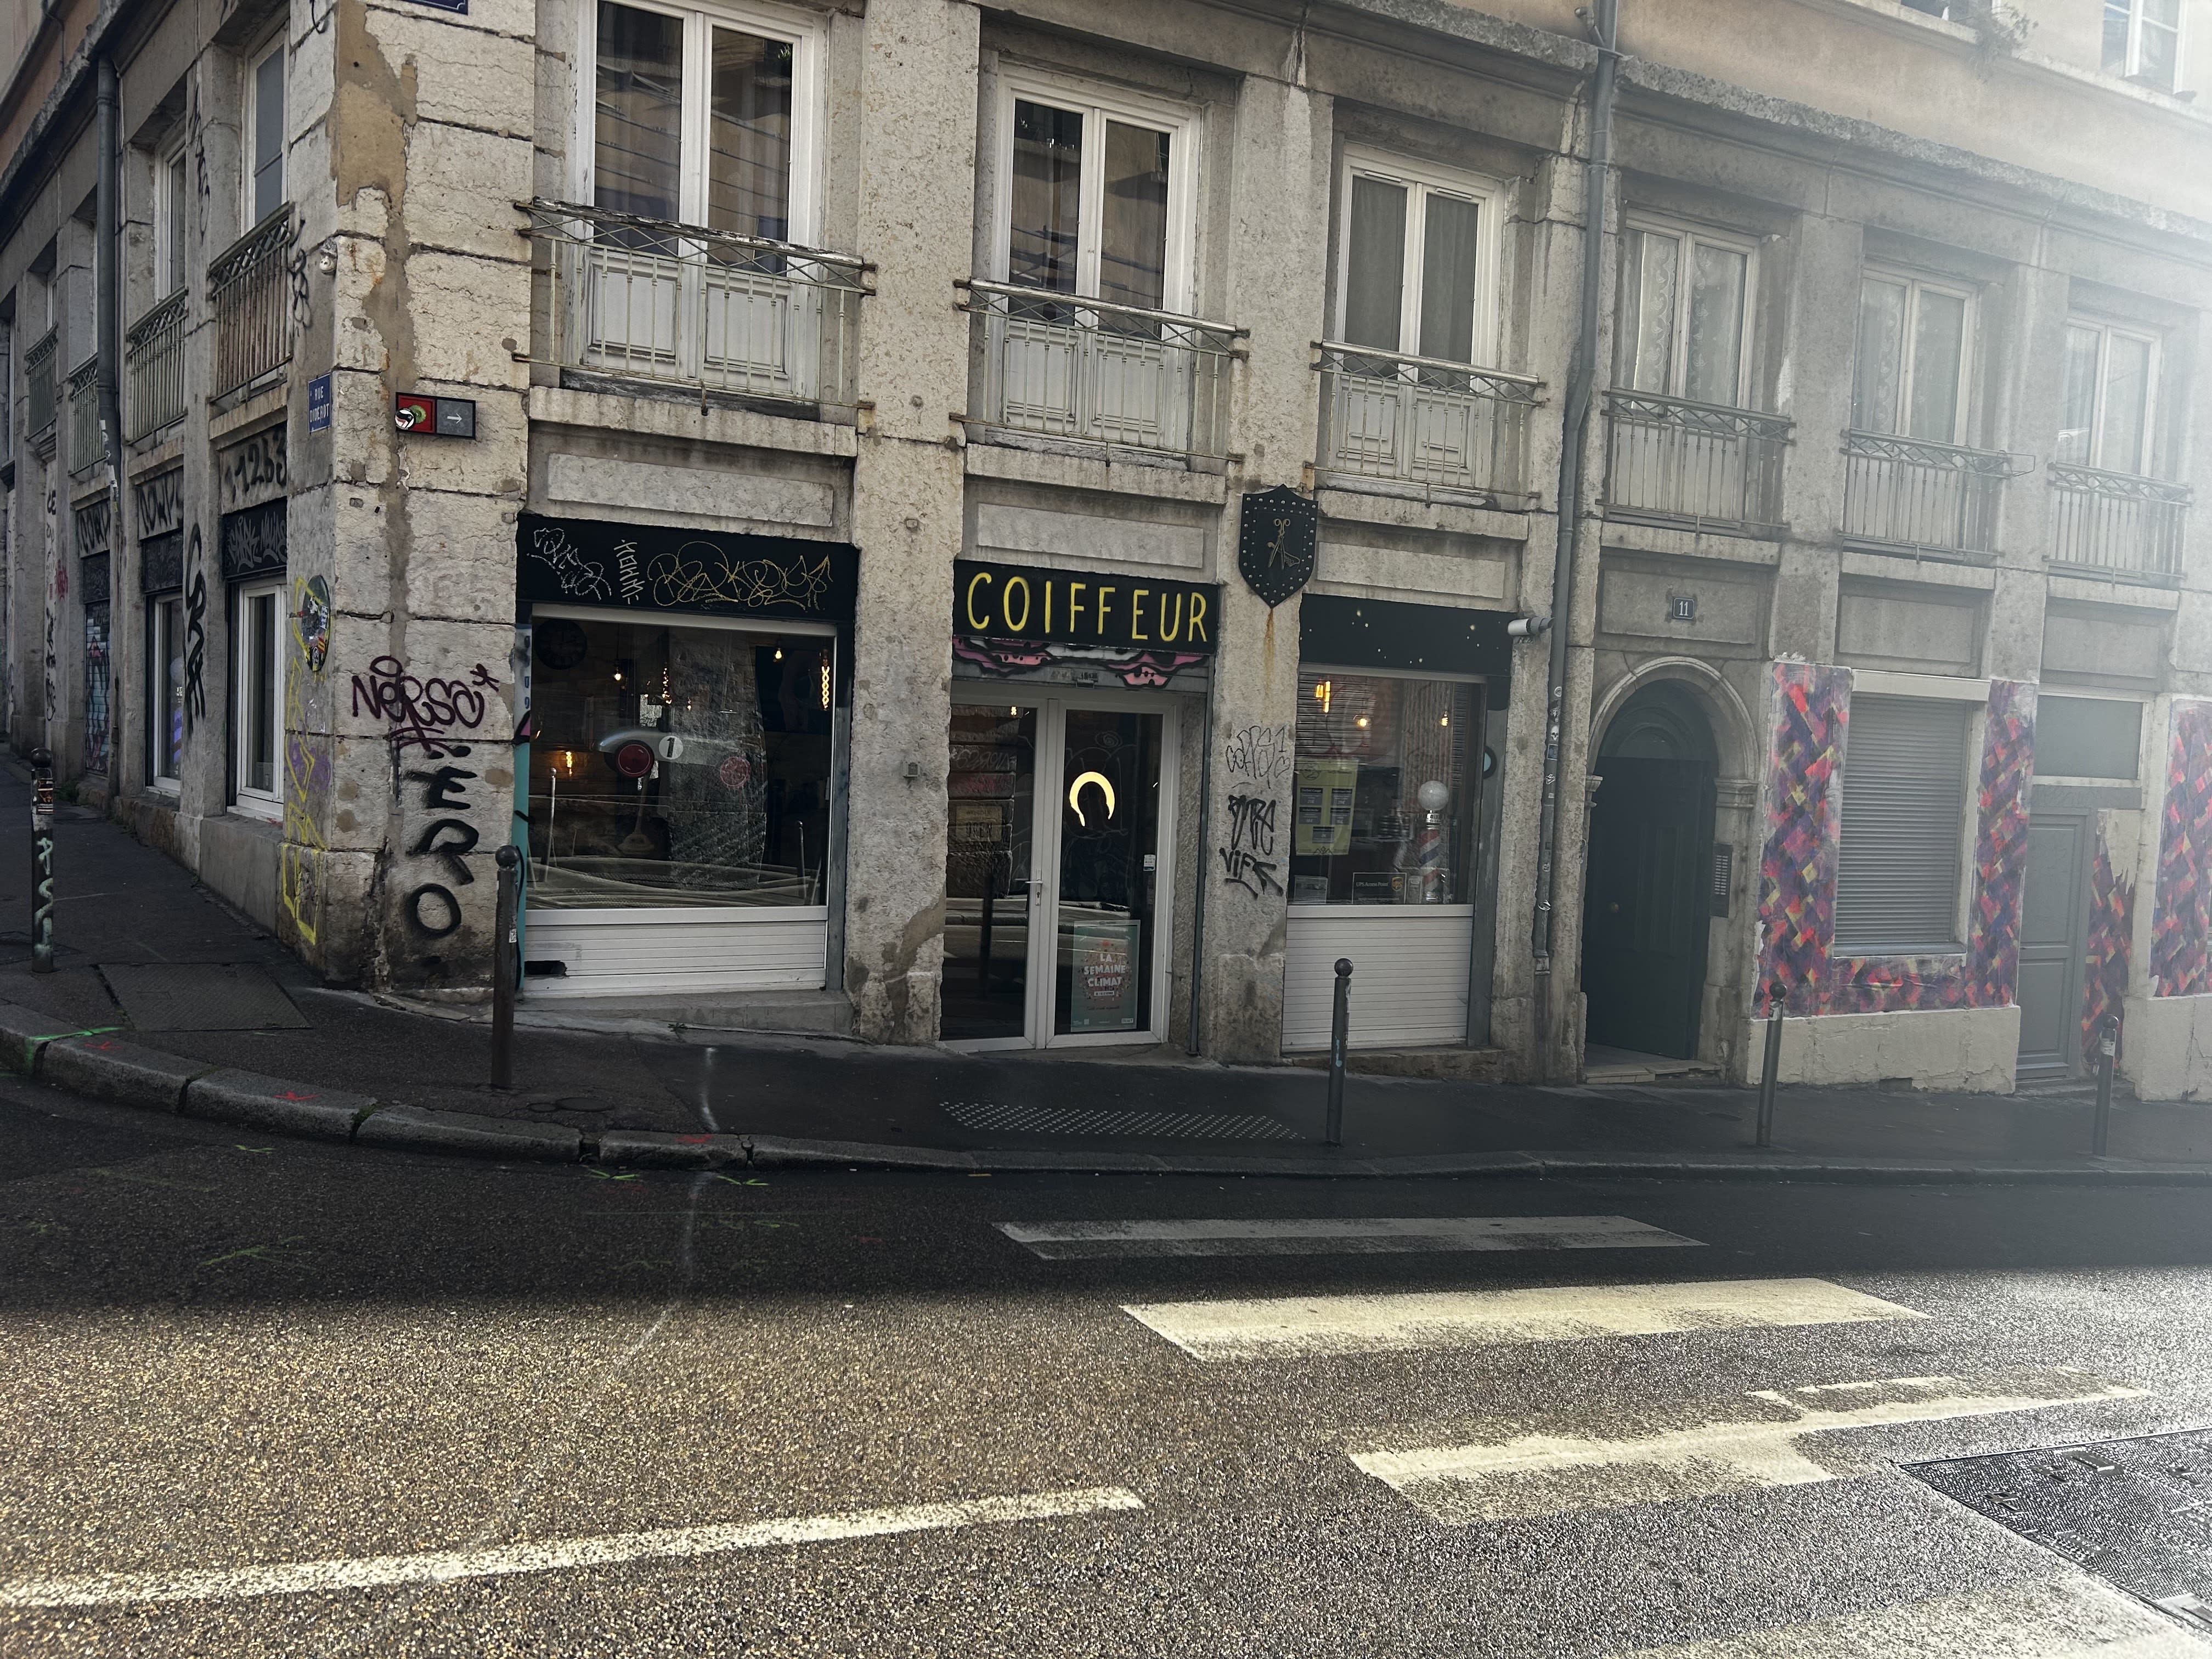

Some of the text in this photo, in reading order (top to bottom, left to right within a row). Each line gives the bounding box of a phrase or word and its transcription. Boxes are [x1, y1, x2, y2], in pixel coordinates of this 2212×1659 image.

[314, 386, 324, 400] RUE
[309, 403, 330, 422] DIDEROT
[967, 572, 1207, 642] COIFFEUR
[1679, 601, 1689, 616] 11
[667, 737, 675, 757] 1
[1100, 952, 1113, 962] LA
[1084, 964, 1126, 975] SEMAINE
[1087, 977, 1122, 988] CLIMAT
